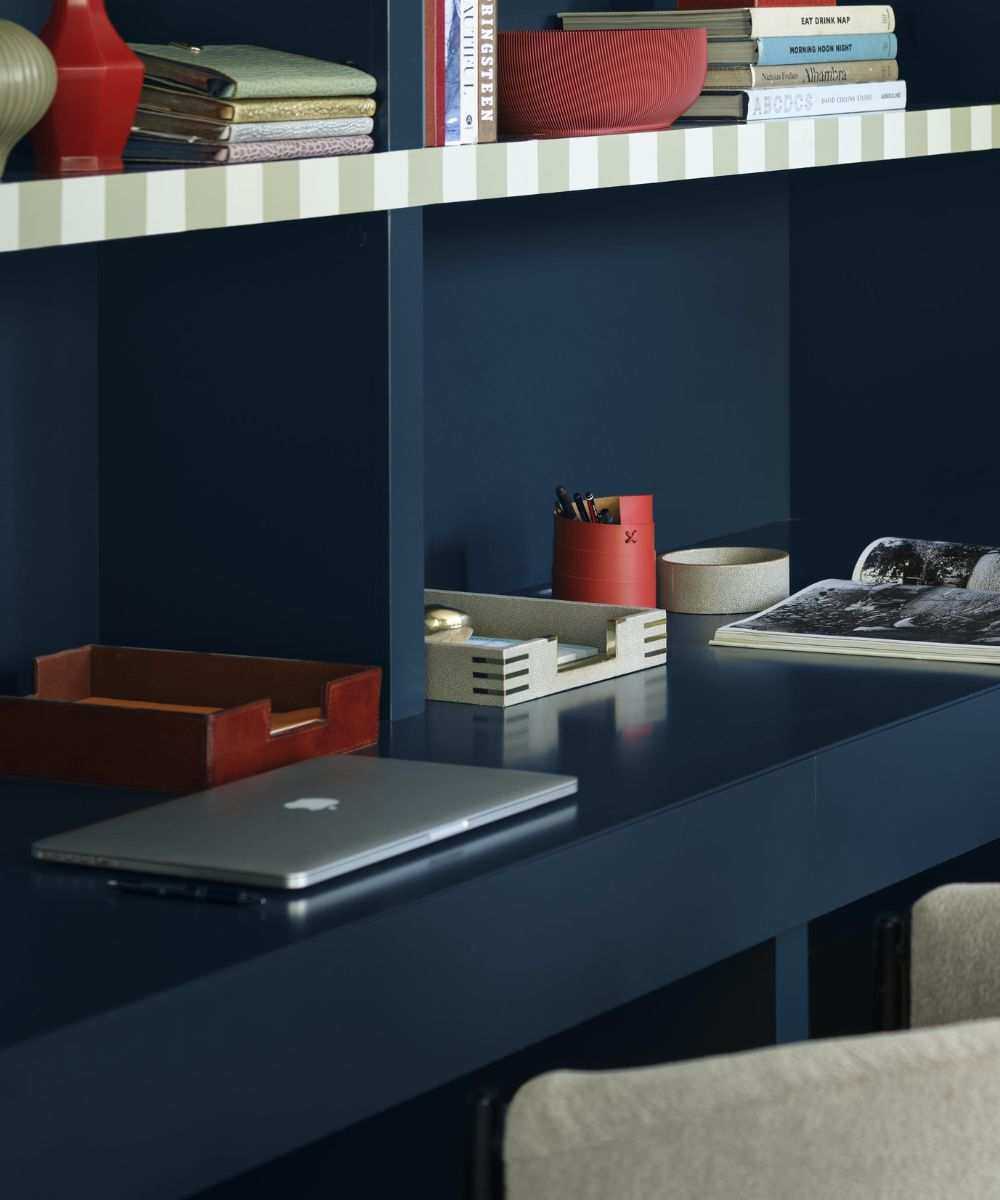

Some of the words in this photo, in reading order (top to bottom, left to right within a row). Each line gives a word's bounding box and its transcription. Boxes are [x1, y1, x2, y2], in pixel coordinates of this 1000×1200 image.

[801, 17, 813, 25] EAT
[814, 16, 836, 25] DRINK
[836, 16, 851, 25] NAP
[789, 45, 817, 55] MORNING
[817, 44, 834, 53] NOON
[835, 43, 853, 52] NIGHT
[804, 66, 847, 83] Alhambra
